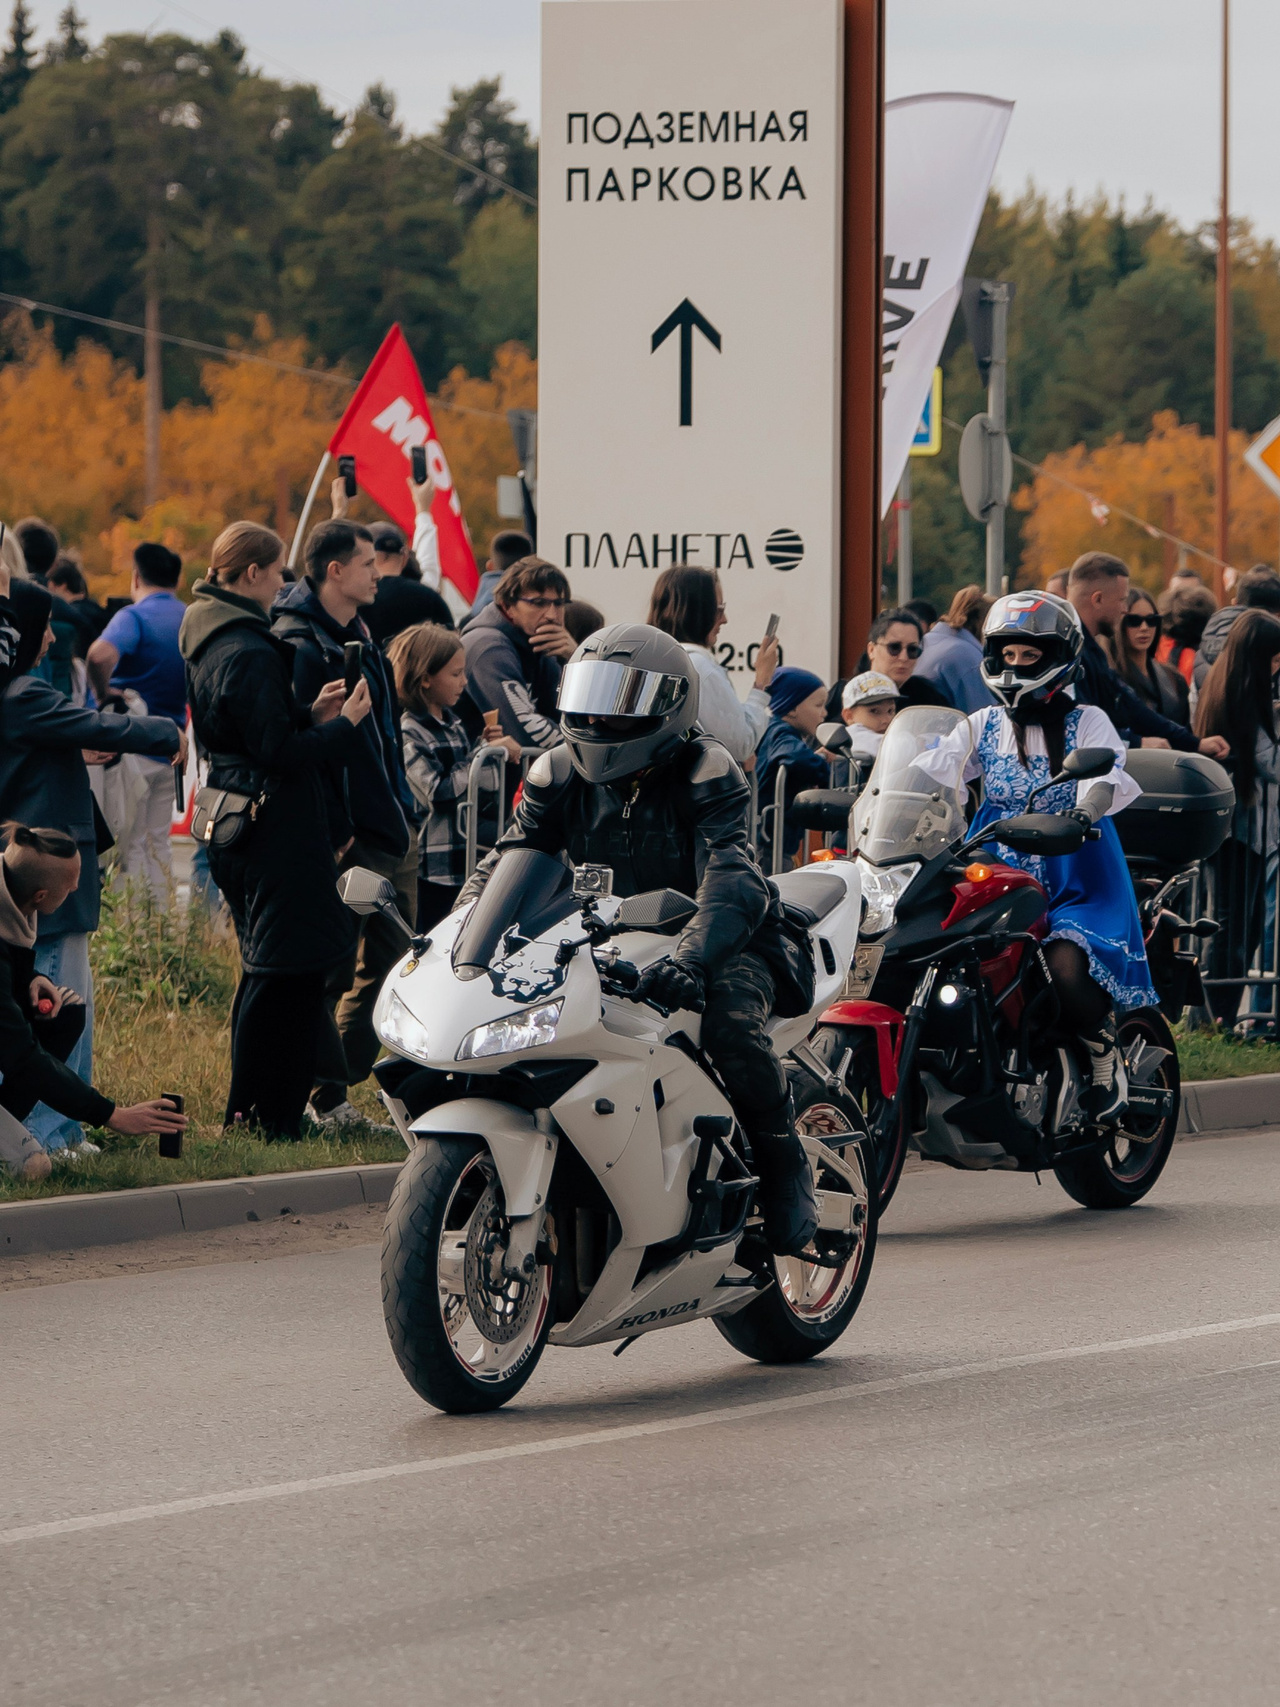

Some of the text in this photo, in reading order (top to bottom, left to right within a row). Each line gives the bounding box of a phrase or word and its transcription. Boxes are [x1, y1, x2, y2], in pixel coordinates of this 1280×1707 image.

[567, 109, 808, 150] ПОДЗЕМНАЯ
[566, 165, 808, 202] ПАРКОВКА
[564, 532, 754, 569] ПЛАНЕТА
[614, 1297, 701, 1331] HONDA
